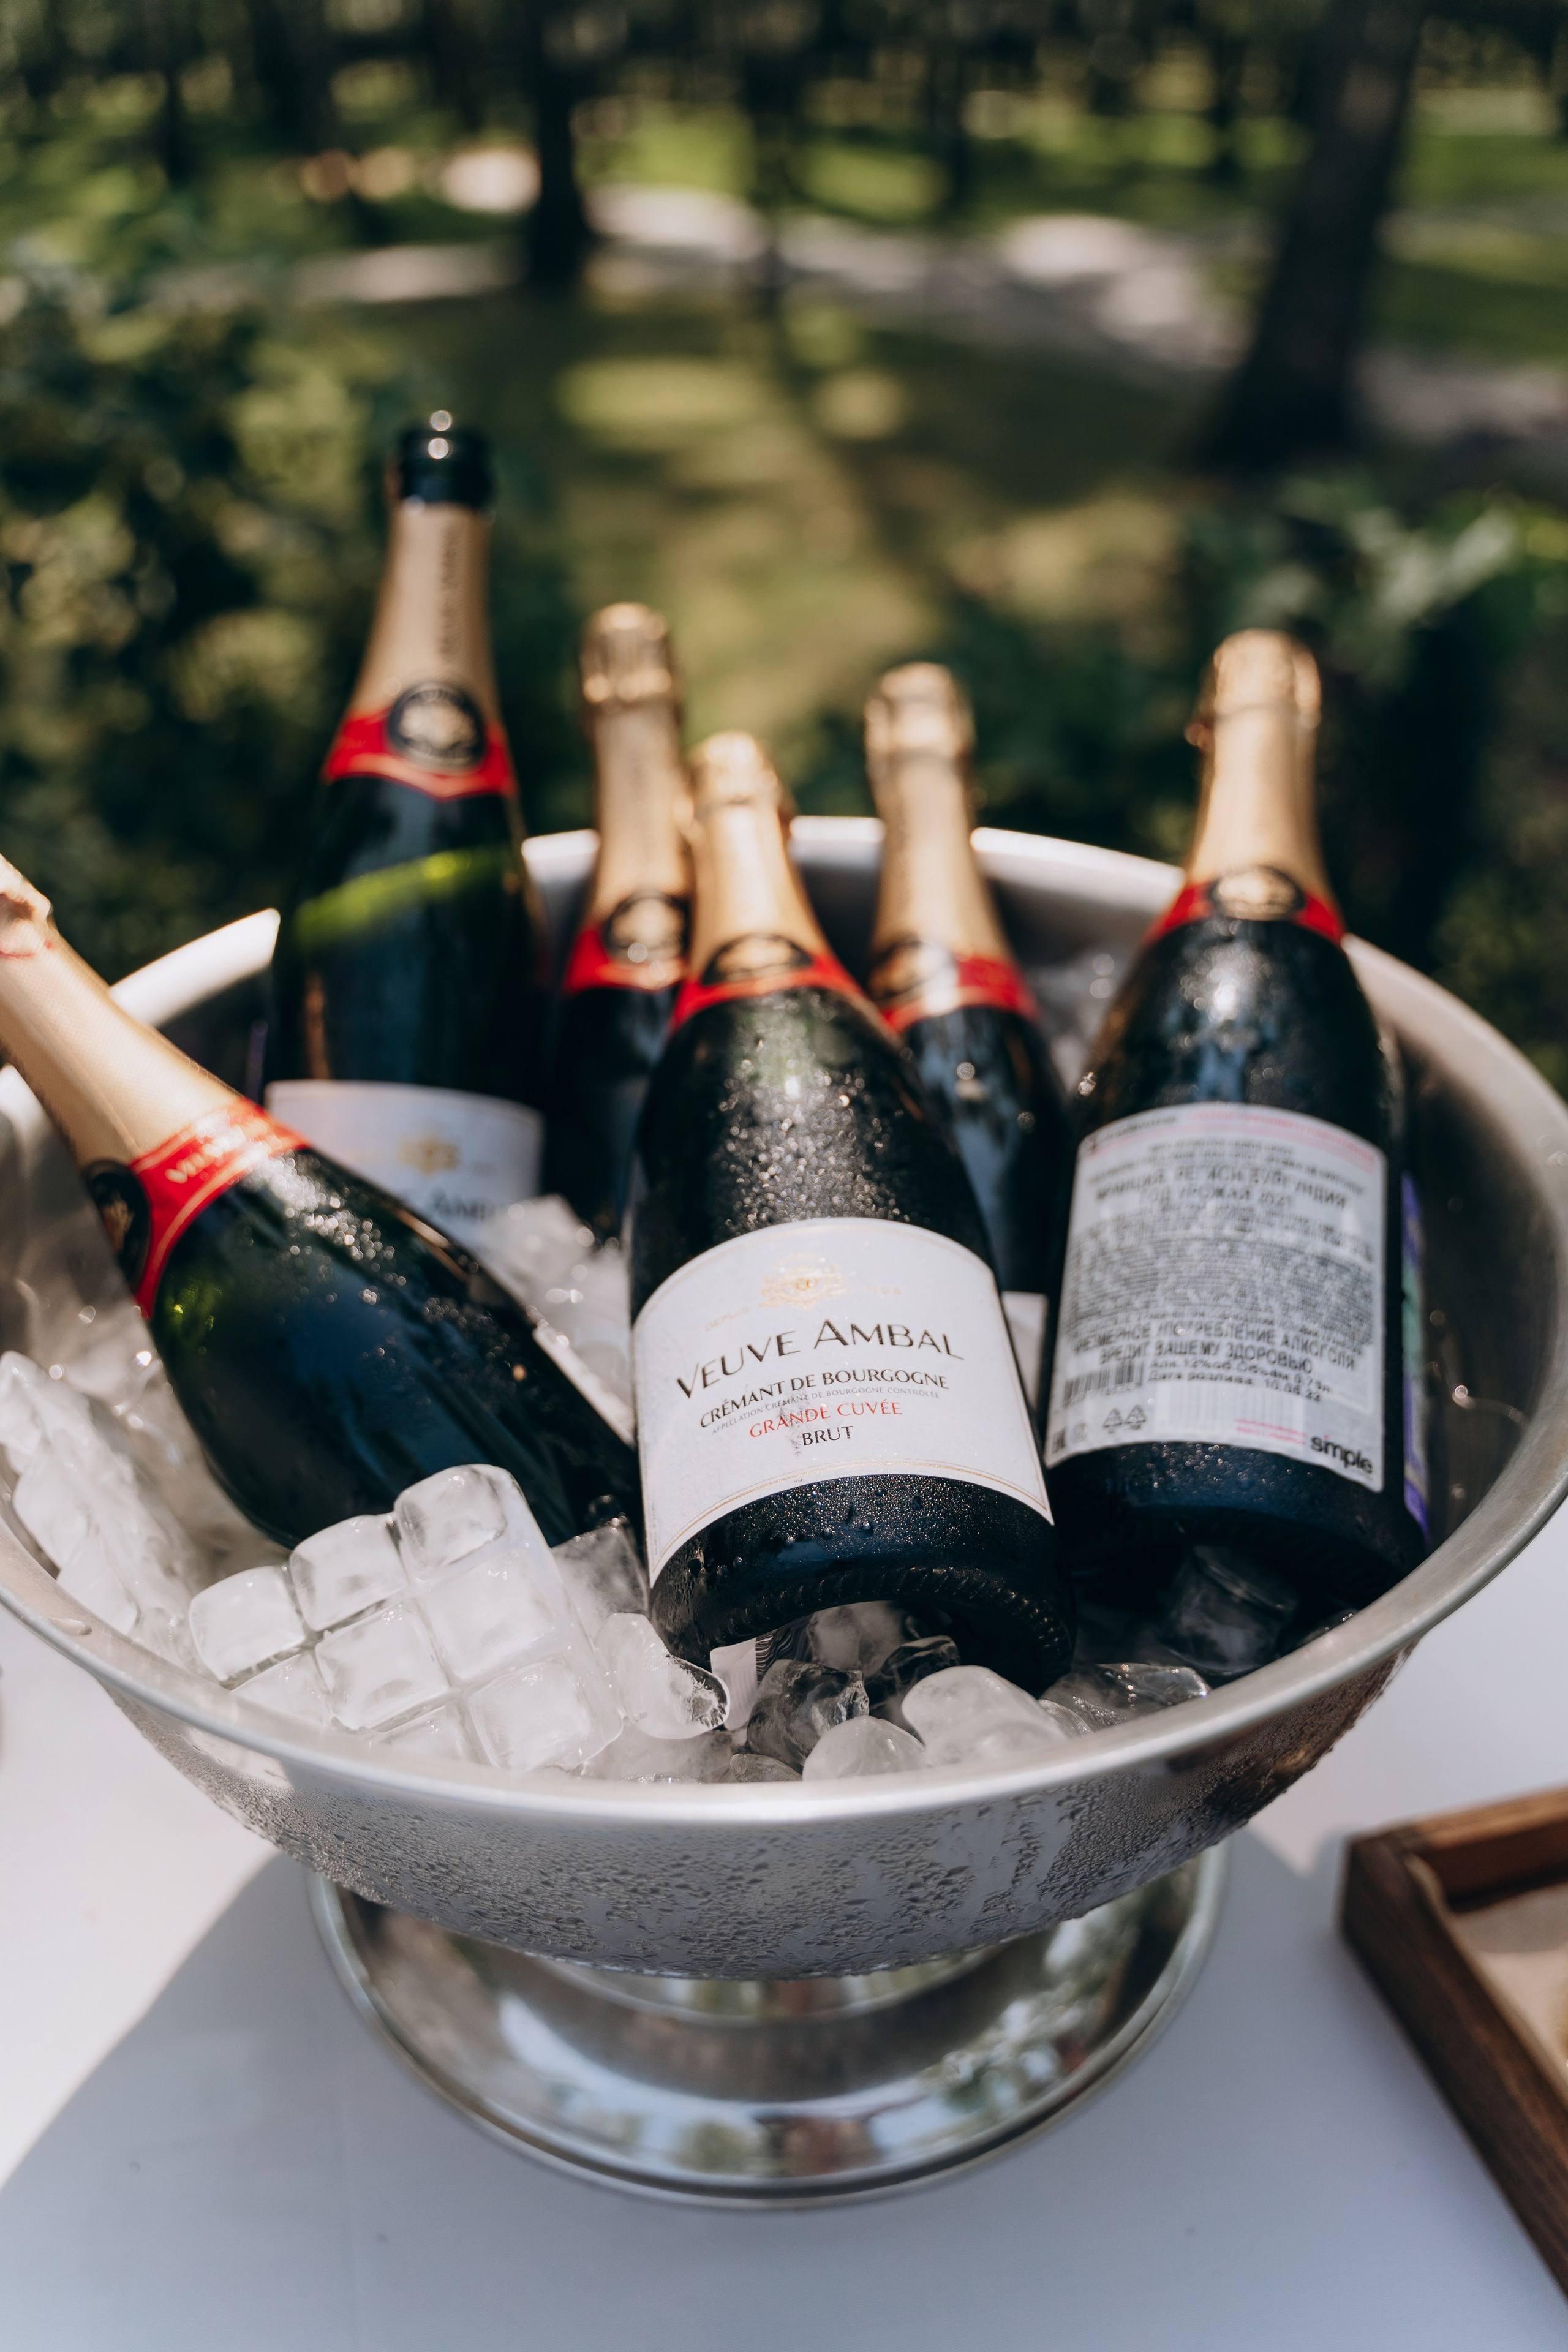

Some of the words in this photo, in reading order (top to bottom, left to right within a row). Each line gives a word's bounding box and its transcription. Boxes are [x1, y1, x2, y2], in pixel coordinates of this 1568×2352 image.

[677, 1331, 801, 1398] VEUVE
[813, 1319, 964, 1360] AMBAL
[700, 1381, 785, 1428] CRÉMANT
[791, 1374, 817, 1392] DE
[821, 1368, 949, 1390] BOURGOGNE
[712, 1408, 763, 1434] APPELLATION
[827, 1387, 884, 1396] BOURGOGNE
[750, 1406, 831, 1438] GRANDE
[837, 1398, 903, 1417] CUVÉE
[801, 1425, 854, 1446] BRUT
[1310, 1434, 1374, 1474] simple
